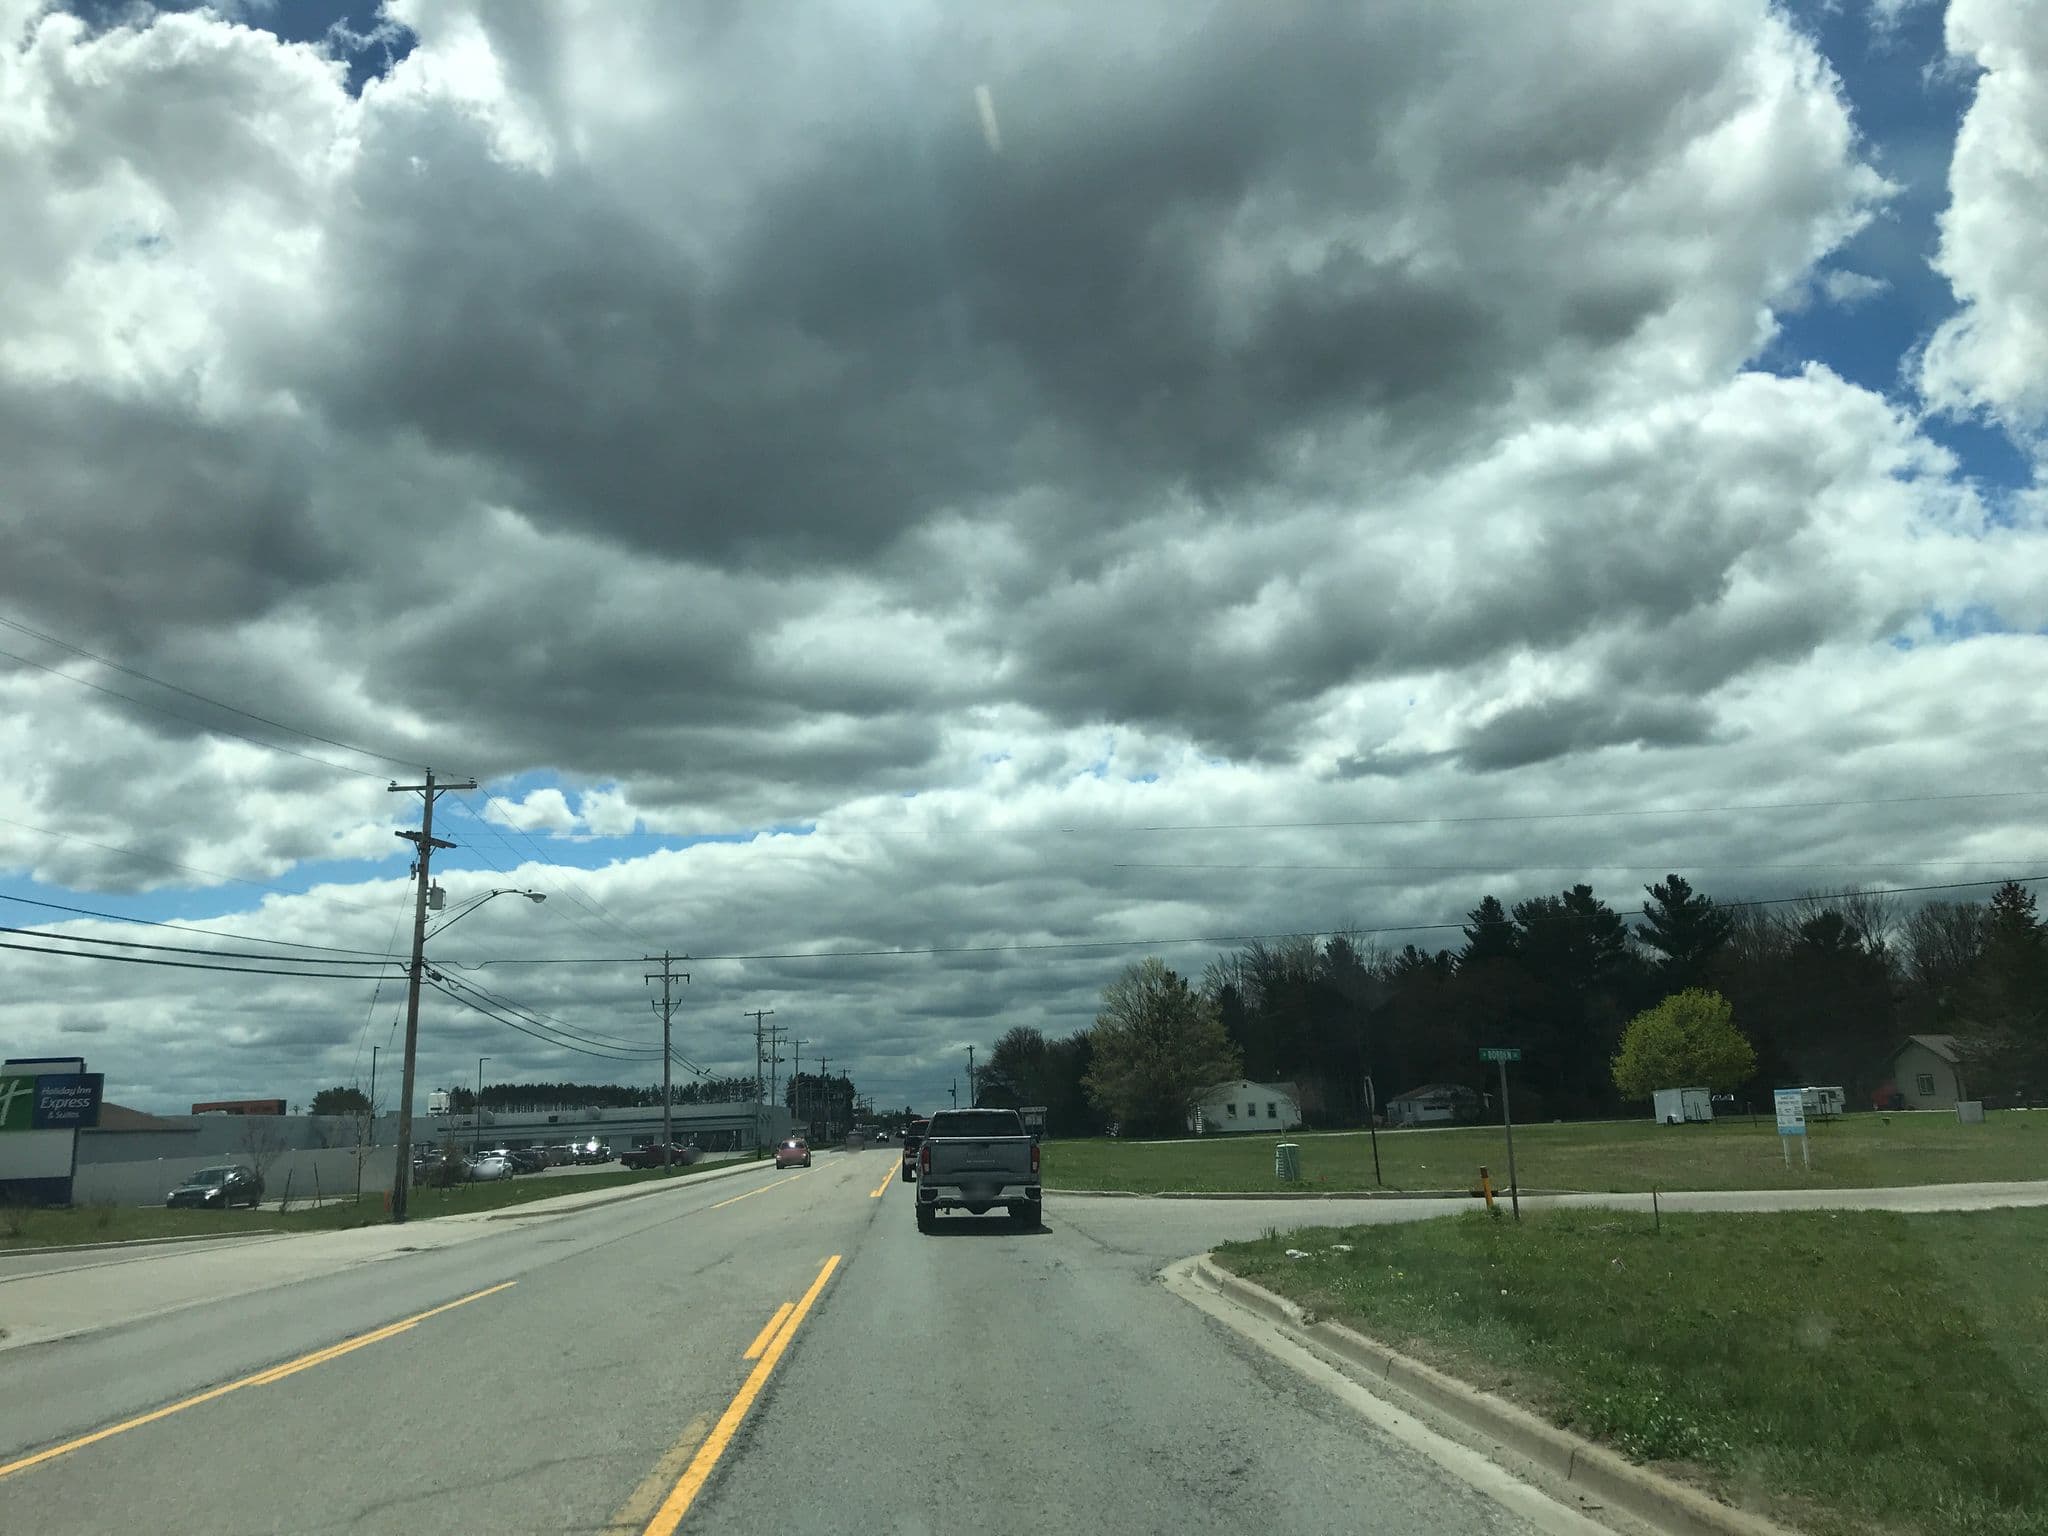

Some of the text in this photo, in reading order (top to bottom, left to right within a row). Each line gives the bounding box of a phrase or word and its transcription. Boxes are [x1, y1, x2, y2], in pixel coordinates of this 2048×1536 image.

[41, 1085, 92, 1096] Holiday Inn
[40, 1096, 91, 1111] Express
